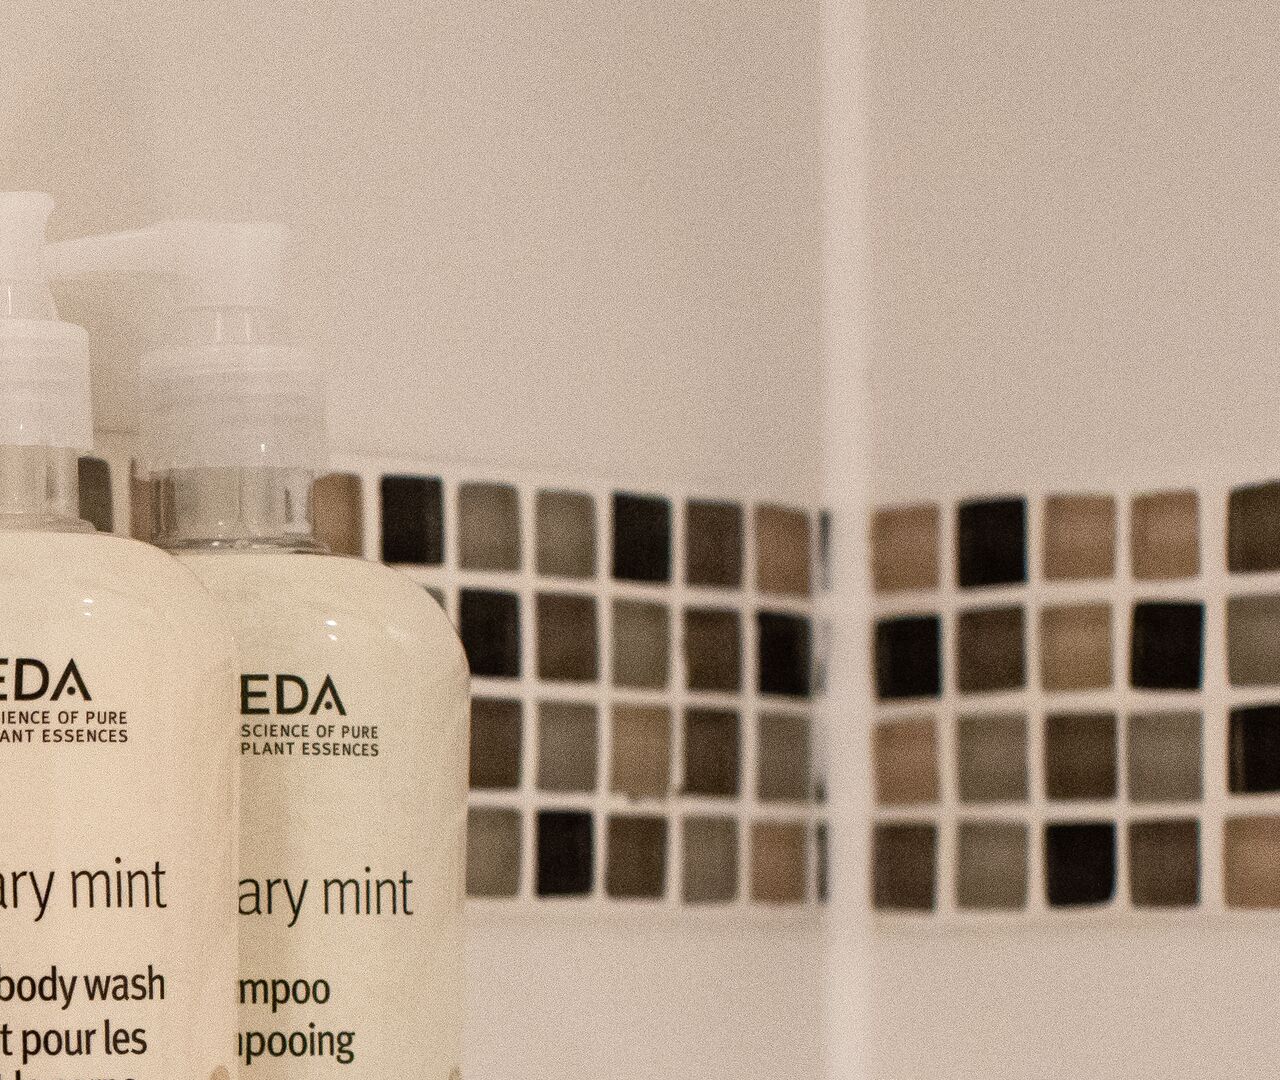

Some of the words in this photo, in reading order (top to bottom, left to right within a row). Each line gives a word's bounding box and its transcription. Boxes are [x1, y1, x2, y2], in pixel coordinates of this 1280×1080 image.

[57, 710, 79, 725] OF
[85, 710, 128, 726] PURE
[240, 723, 309, 738] SCIENCE
[316, 724, 335, 739] OF
[341, 724, 378, 740] PURE
[41, 728, 129, 744] ESSENCES
[240, 741, 295, 756] PLANT
[301, 742, 380, 758] ESSENCES
[70, 856, 168, 911] mint
[322, 865, 414, 917] mint
[82, 963, 166, 1002] wash
[21, 1028, 97, 1066] pour
[103, 1018, 148, 1056] les
